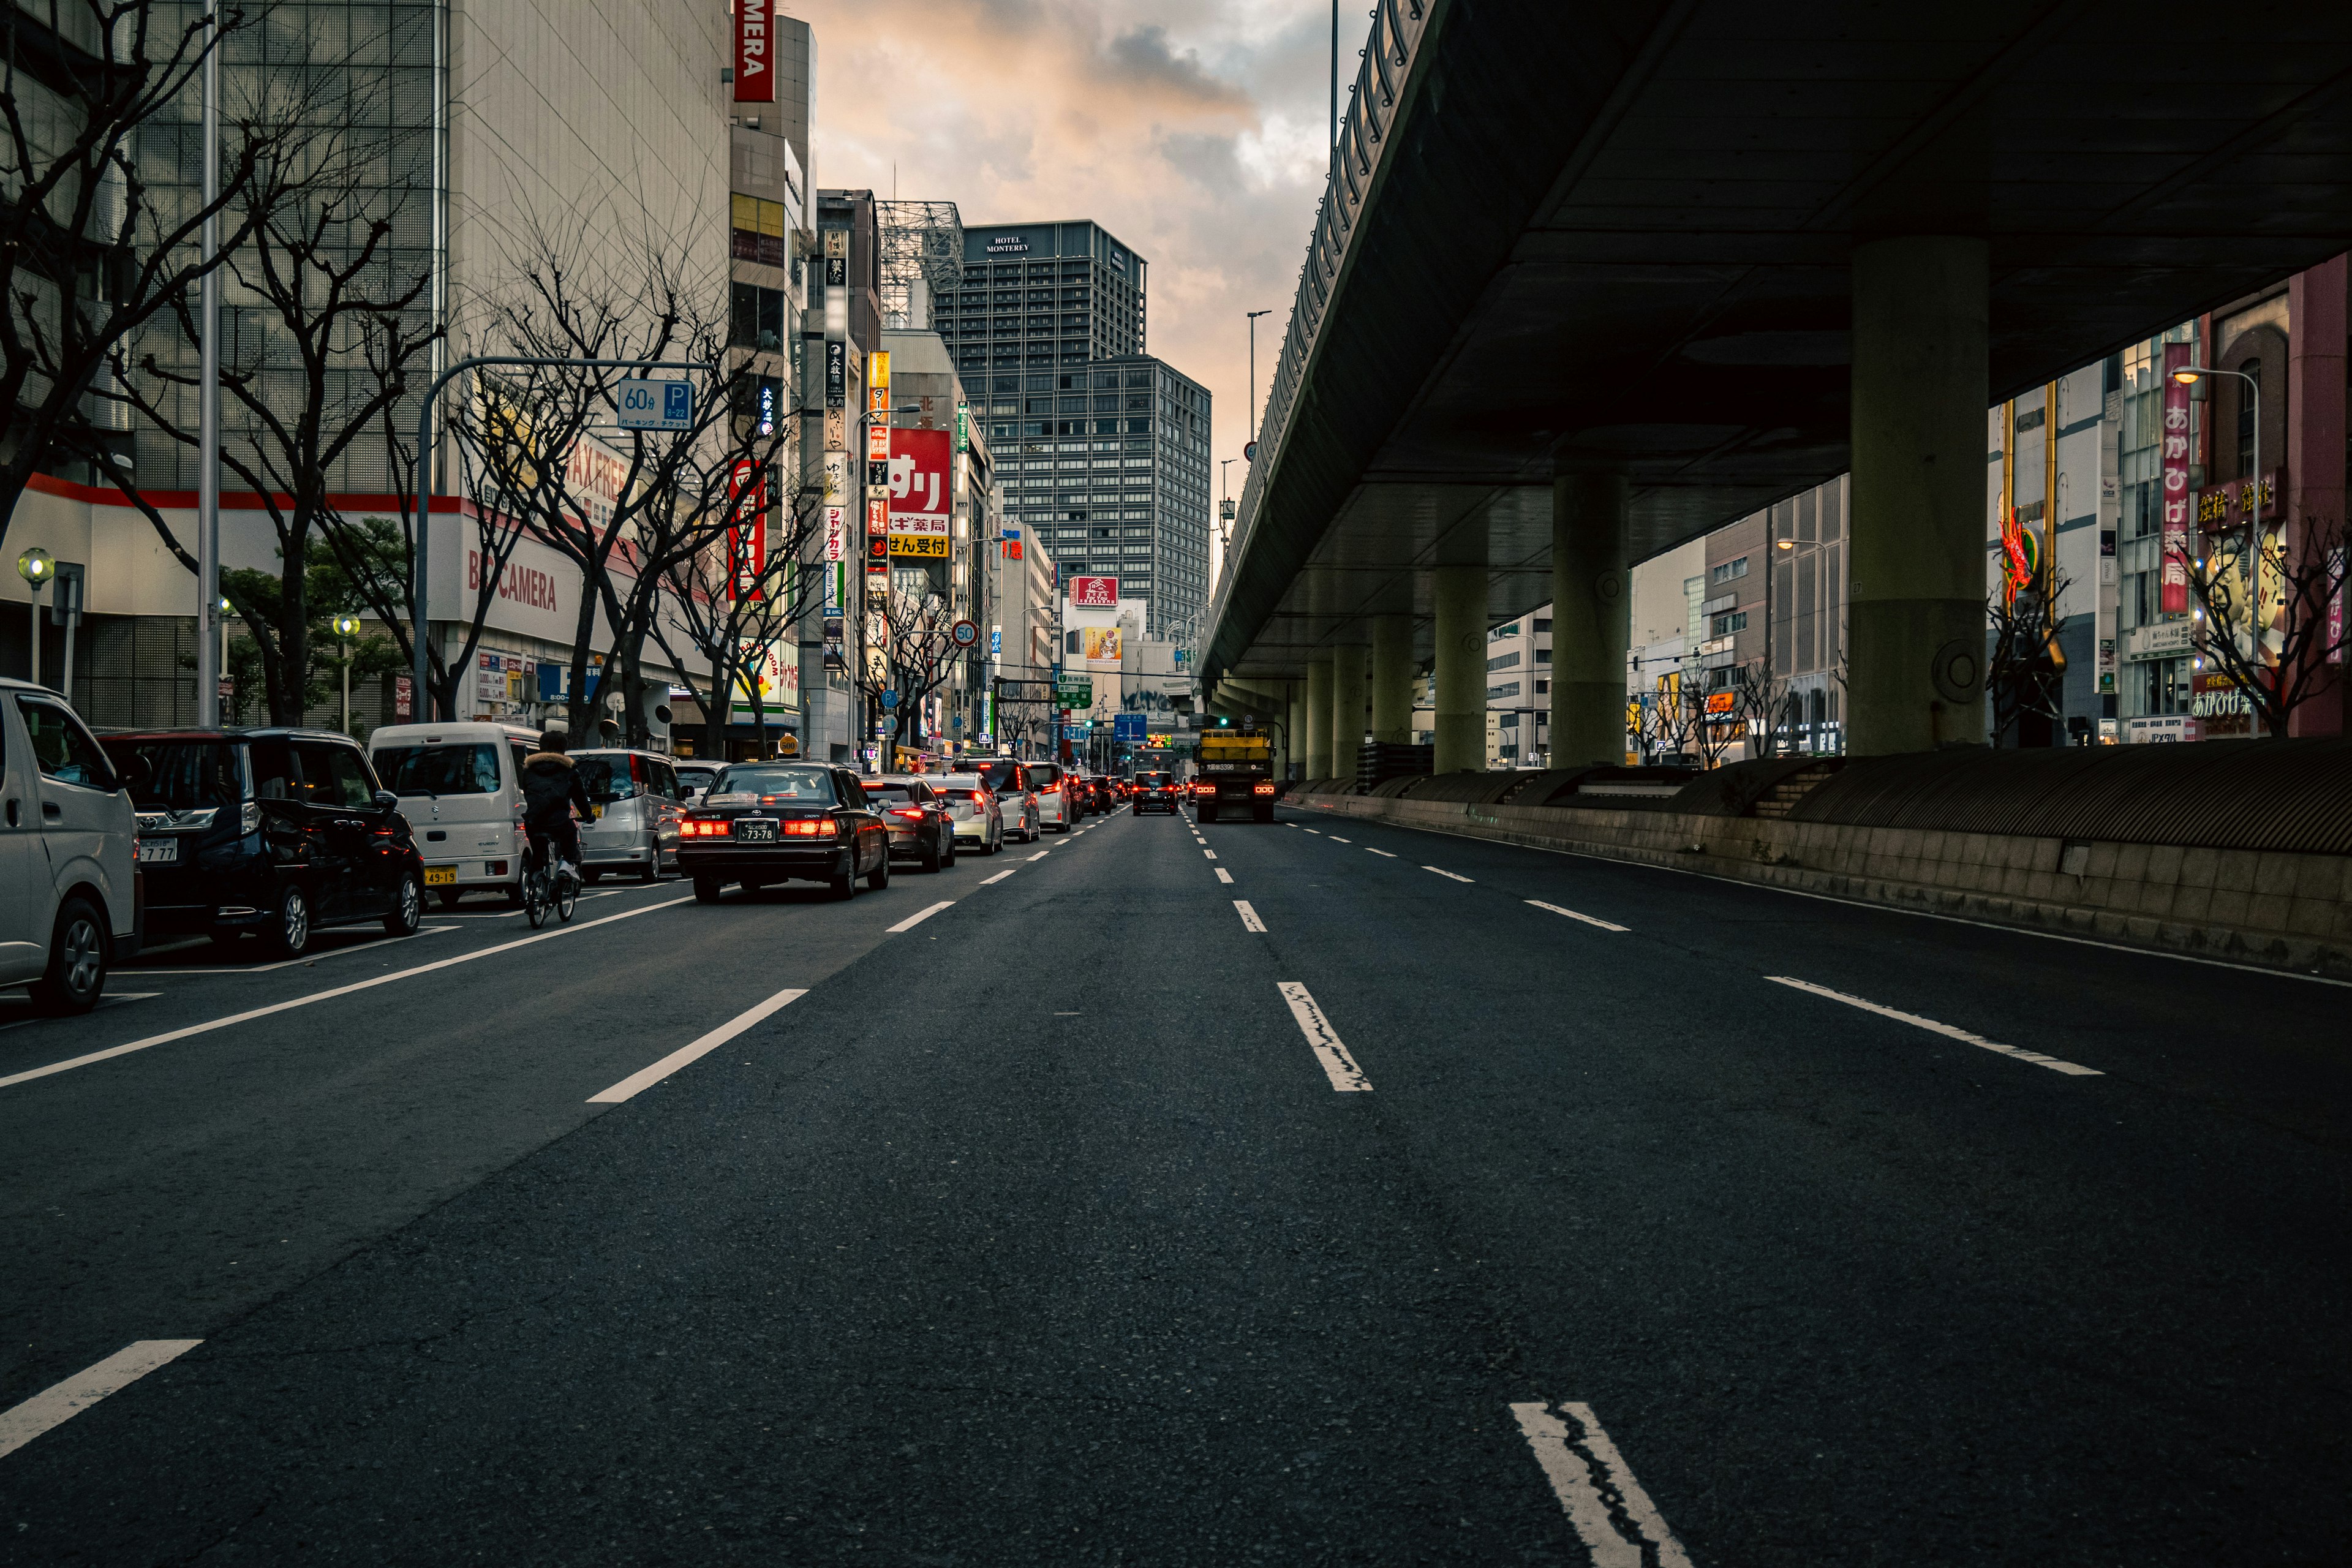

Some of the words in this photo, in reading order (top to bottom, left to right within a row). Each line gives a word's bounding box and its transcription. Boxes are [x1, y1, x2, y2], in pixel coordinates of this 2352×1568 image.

[830, 356, 841, 384] 大牧場
[625, 388, 655, 410] 60分
[595, 450, 625, 503] FREE
[2164, 404, 2188, 586] あかひげ薬局
[829, 509, 840, 560] ジャンカラ
[498, 560, 557, 612] CAMERA
[957, 628, 973, 639] 50
[2192, 689, 2266, 718] あかひげ薬
[747, 830, 772, 839] 73-78
[429, 873, 455, 883] 49-19
